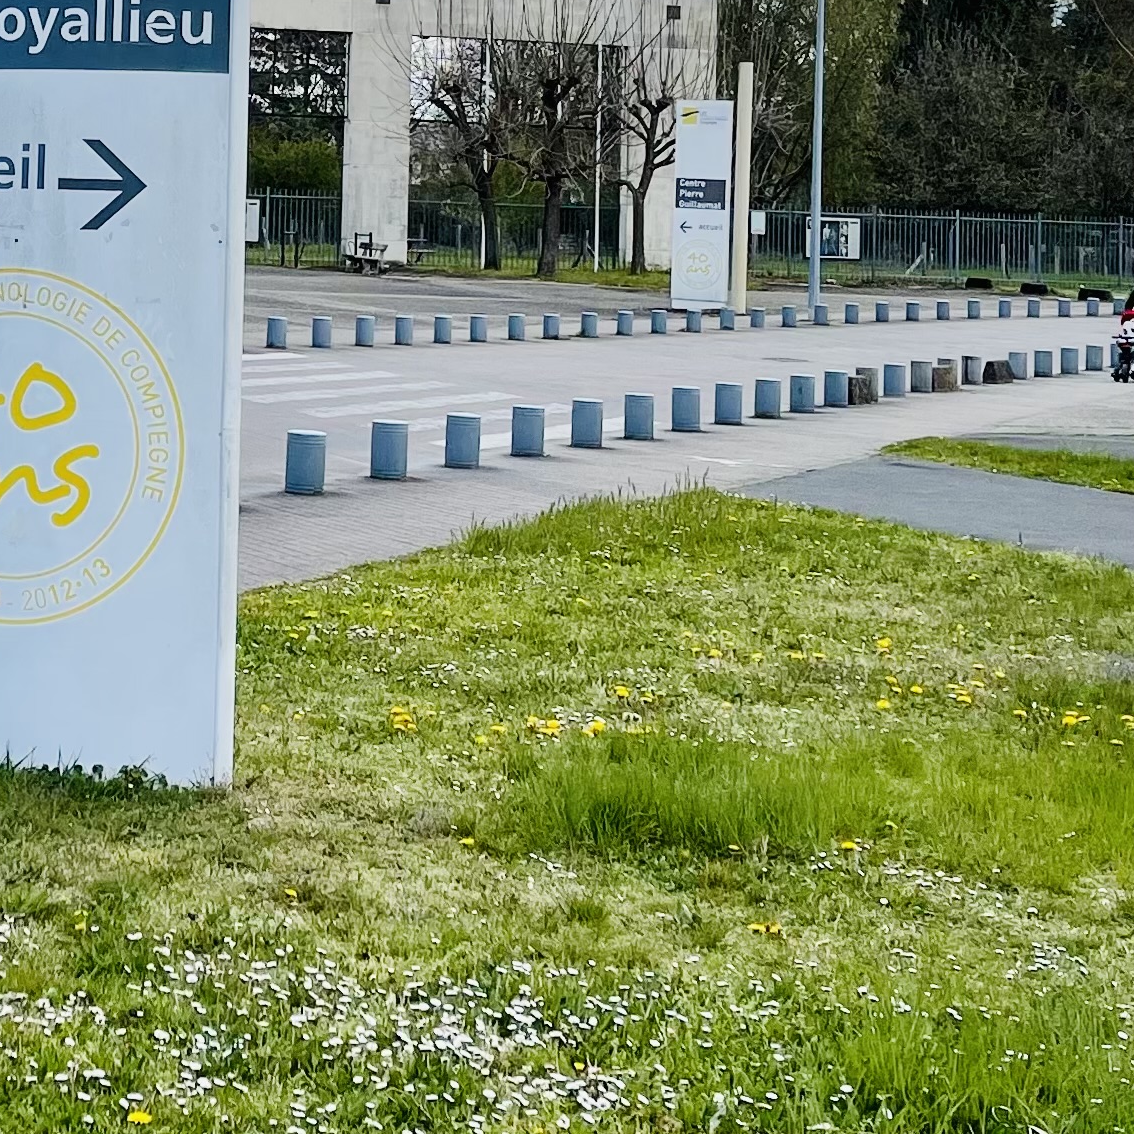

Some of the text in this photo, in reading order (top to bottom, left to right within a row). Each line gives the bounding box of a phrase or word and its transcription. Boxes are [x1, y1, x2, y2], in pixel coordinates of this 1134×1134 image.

[679, 178, 706, 188] Centre
[679, 188, 704, 198] Pierre
[92, 315, 126, 350] DE
[121, 349, 169, 503] COMPIEGNE
